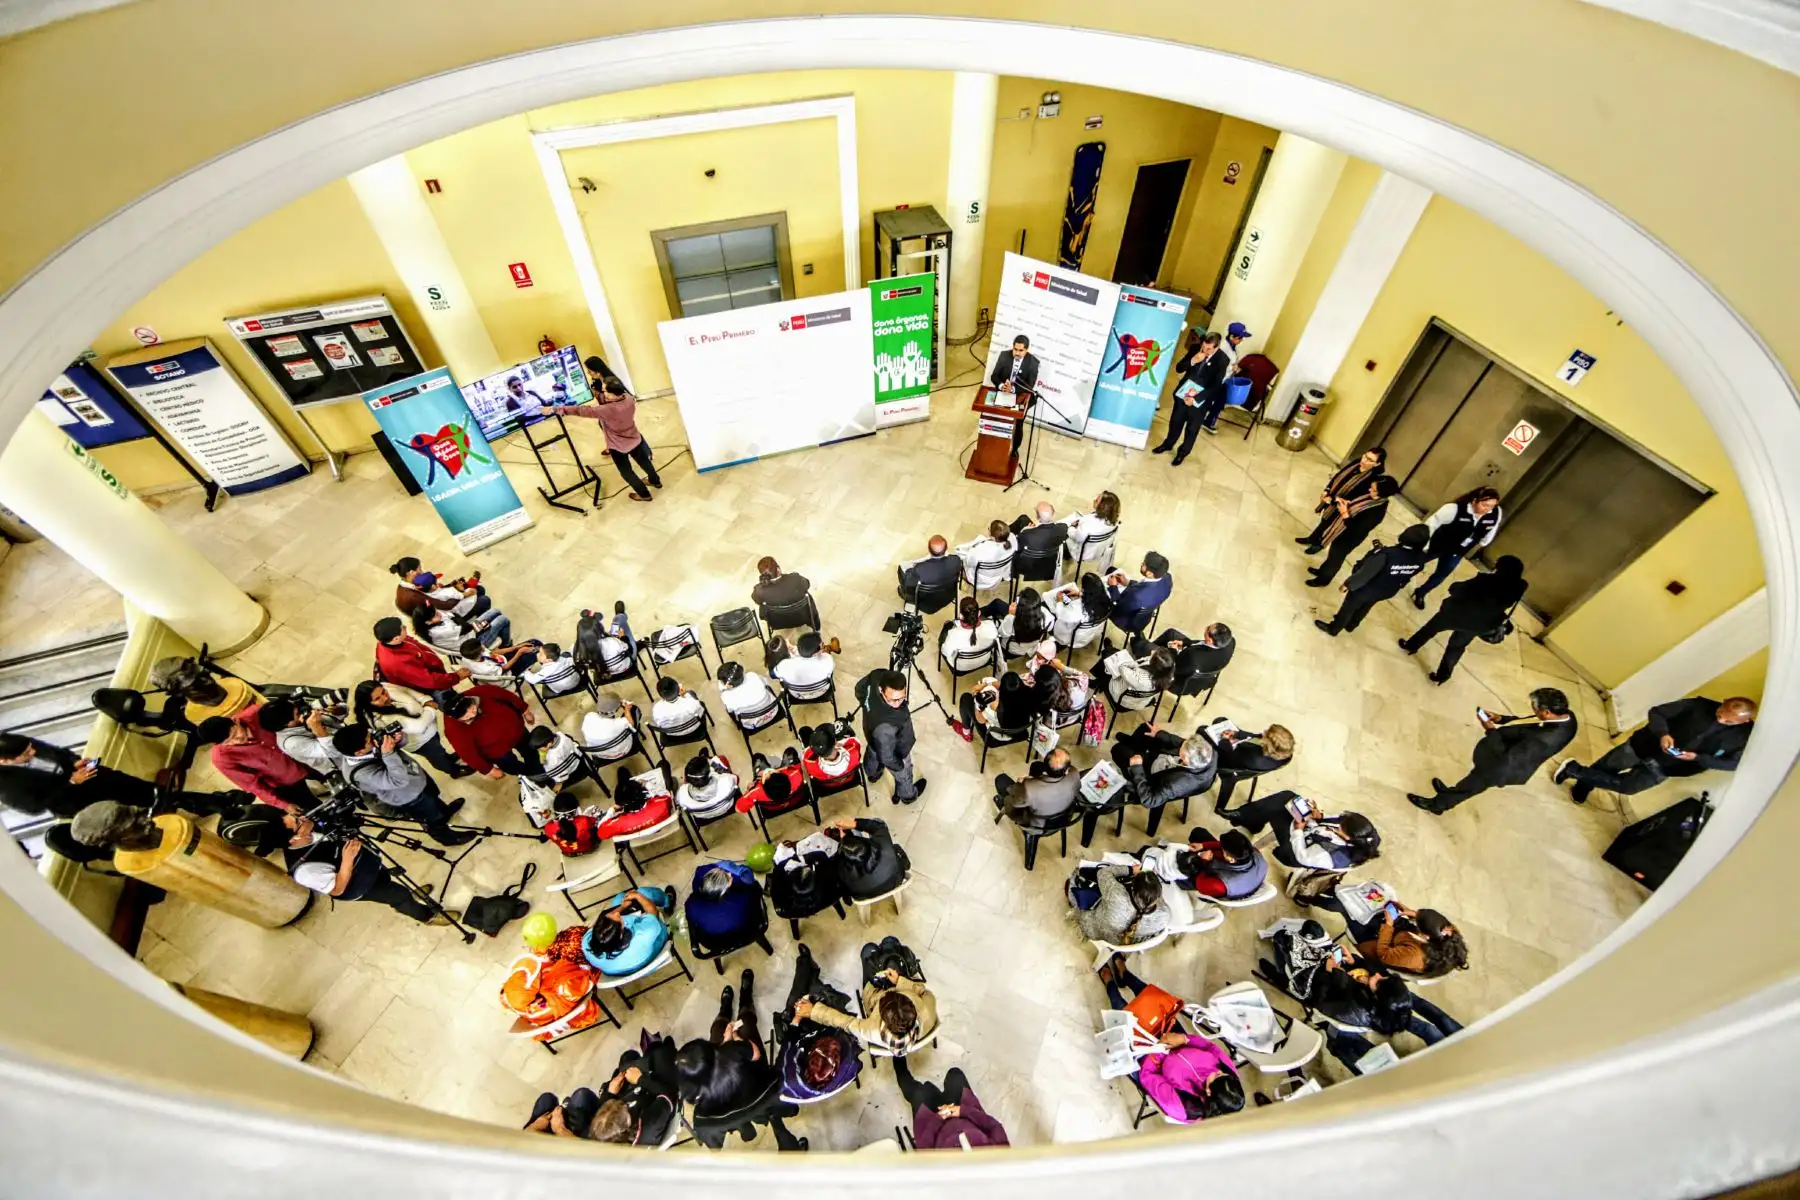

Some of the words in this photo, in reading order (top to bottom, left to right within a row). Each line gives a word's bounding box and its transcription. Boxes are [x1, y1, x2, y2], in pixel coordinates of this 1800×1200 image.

[970, 201, 979, 214] S
[1240, 255, 1251, 270] S
[427, 287, 442, 301] S
[874, 319, 895, 328] dona
[874, 325, 904, 337] dona
[905, 320, 929, 332] vida
[1566, 368, 1578, 381] 1
